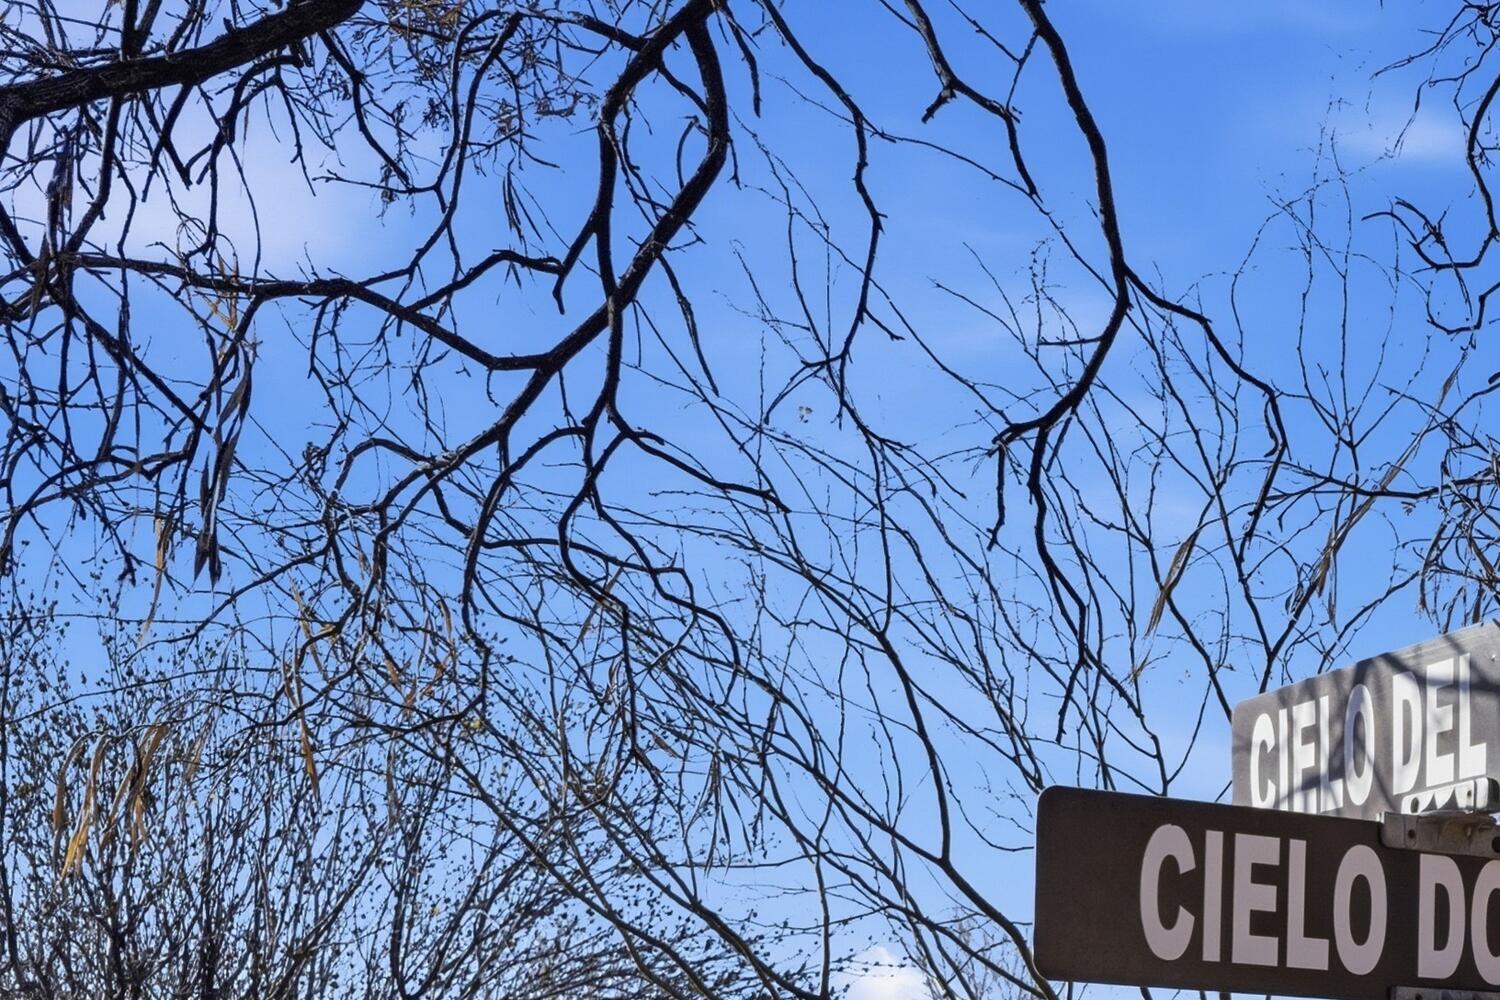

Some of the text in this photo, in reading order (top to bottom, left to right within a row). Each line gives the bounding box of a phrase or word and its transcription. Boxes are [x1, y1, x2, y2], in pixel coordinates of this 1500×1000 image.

[1250, 684, 1375, 813] CIELO
[1392, 653, 1487, 796] DEL
[1139, 824, 1387, 976] CIELO
